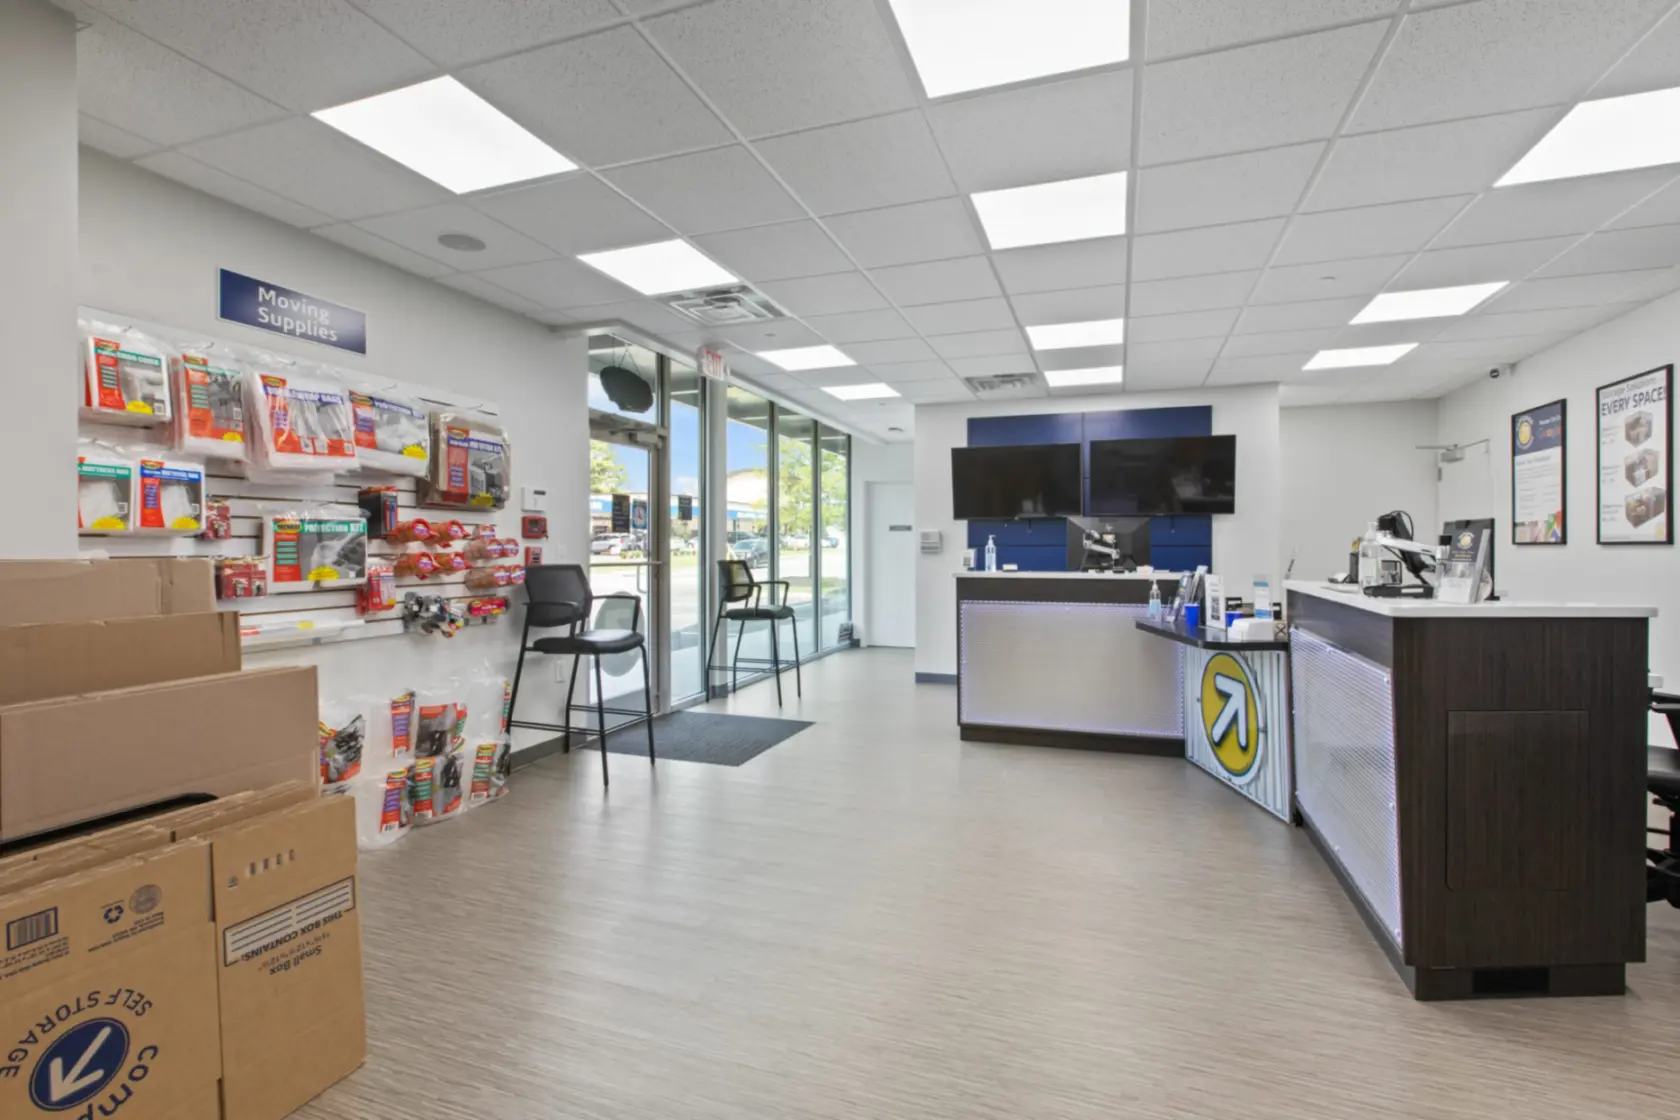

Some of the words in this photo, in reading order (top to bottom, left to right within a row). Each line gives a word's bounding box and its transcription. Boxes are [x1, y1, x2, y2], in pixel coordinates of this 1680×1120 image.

[258, 286, 330, 325] Moving
[258, 307, 338, 341] Supplies
[1601, 396, 1630, 416] EVERY
[300, 919, 322, 936] BOX
[322, 910, 343, 926] THIS
[241, 930, 299, 962] CONTAINS:
[293, 944, 323, 967] Small
[269, 959, 291, 976] Box
[104, 988, 153, 1017] SELF
[0, 990, 101, 1078] STORAGE
